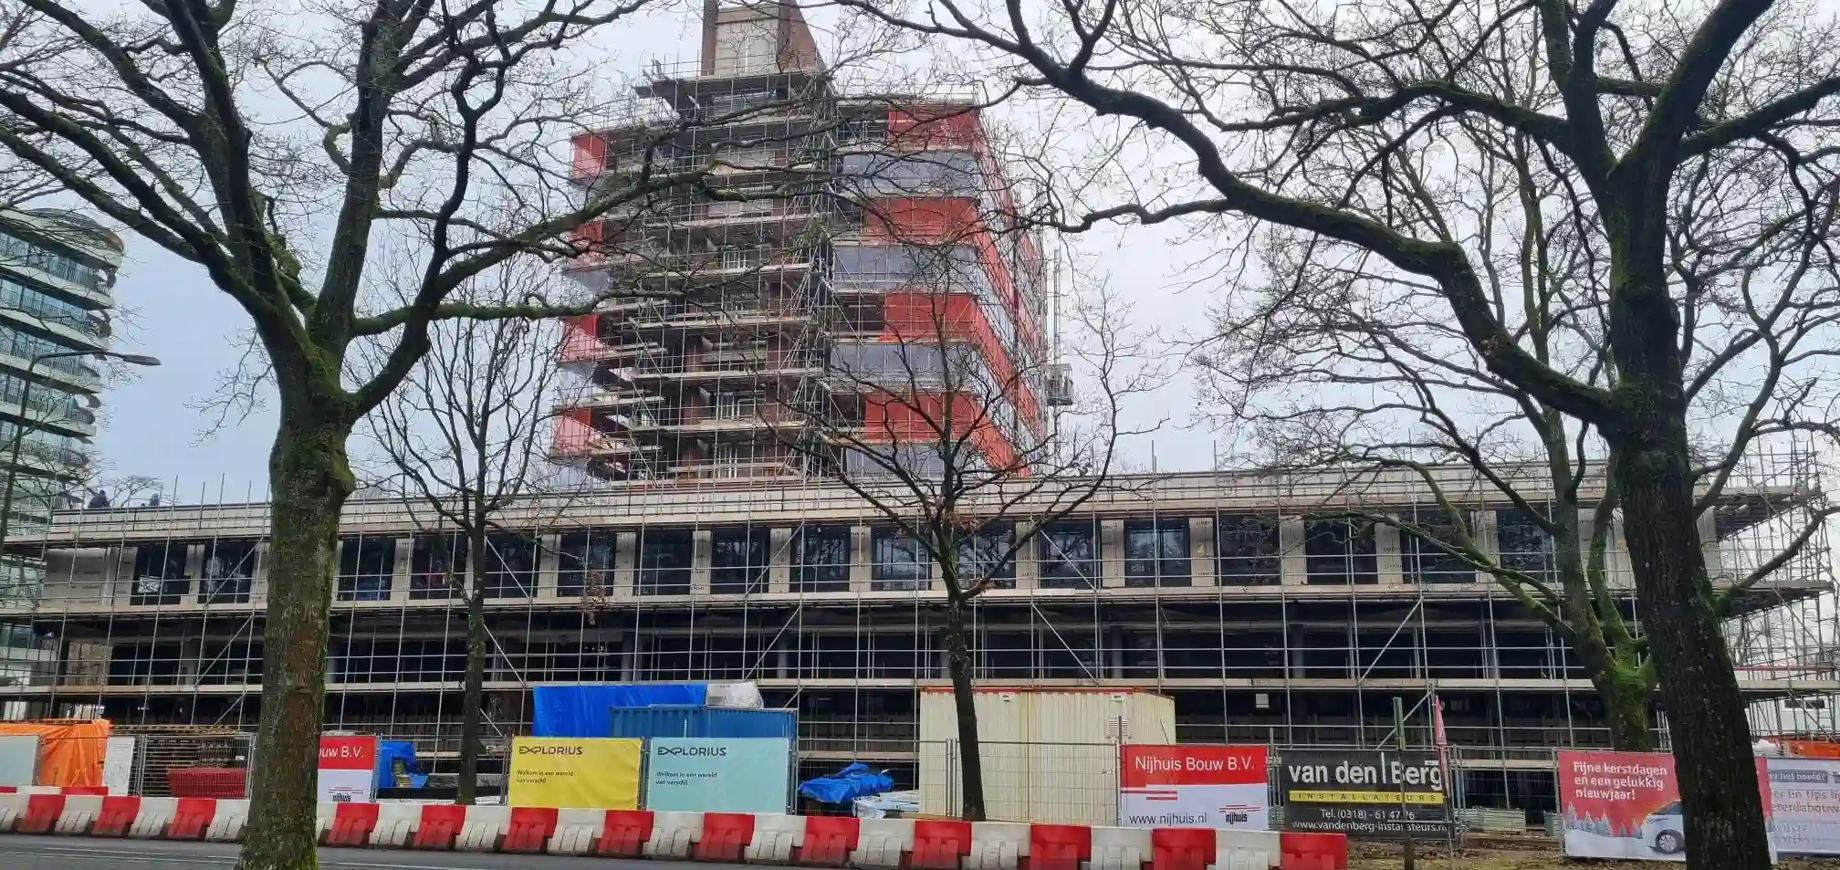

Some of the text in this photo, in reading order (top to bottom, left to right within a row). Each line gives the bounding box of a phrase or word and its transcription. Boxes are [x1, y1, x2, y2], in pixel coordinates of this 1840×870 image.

[341, 745, 364, 758] B.V.
[518, 745, 584, 756] EXPLORIUS
[657, 746, 727, 757] EXPLORIUS
[1135, 755, 1255, 774] Nijhuis Bouw B.V.
[1573, 761, 1667, 777] Fijne kerstdagen
[1288, 760, 1444, 792] van den Berg
[1574, 775, 1664, 791] en een gelukkig
[1297, 792, 1437, 802] INSTALLATEURS
[1575, 787, 1636, 801] nieuwjaar!
[1128, 813, 1208, 827] www.nijhuis.nl
[1225, 812, 1248, 825] nijhuis
[1320, 808, 1336, 819] Tel.
[1337, 808, 1367, 819] (0318)
[1374, 810, 1386, 820] 61
